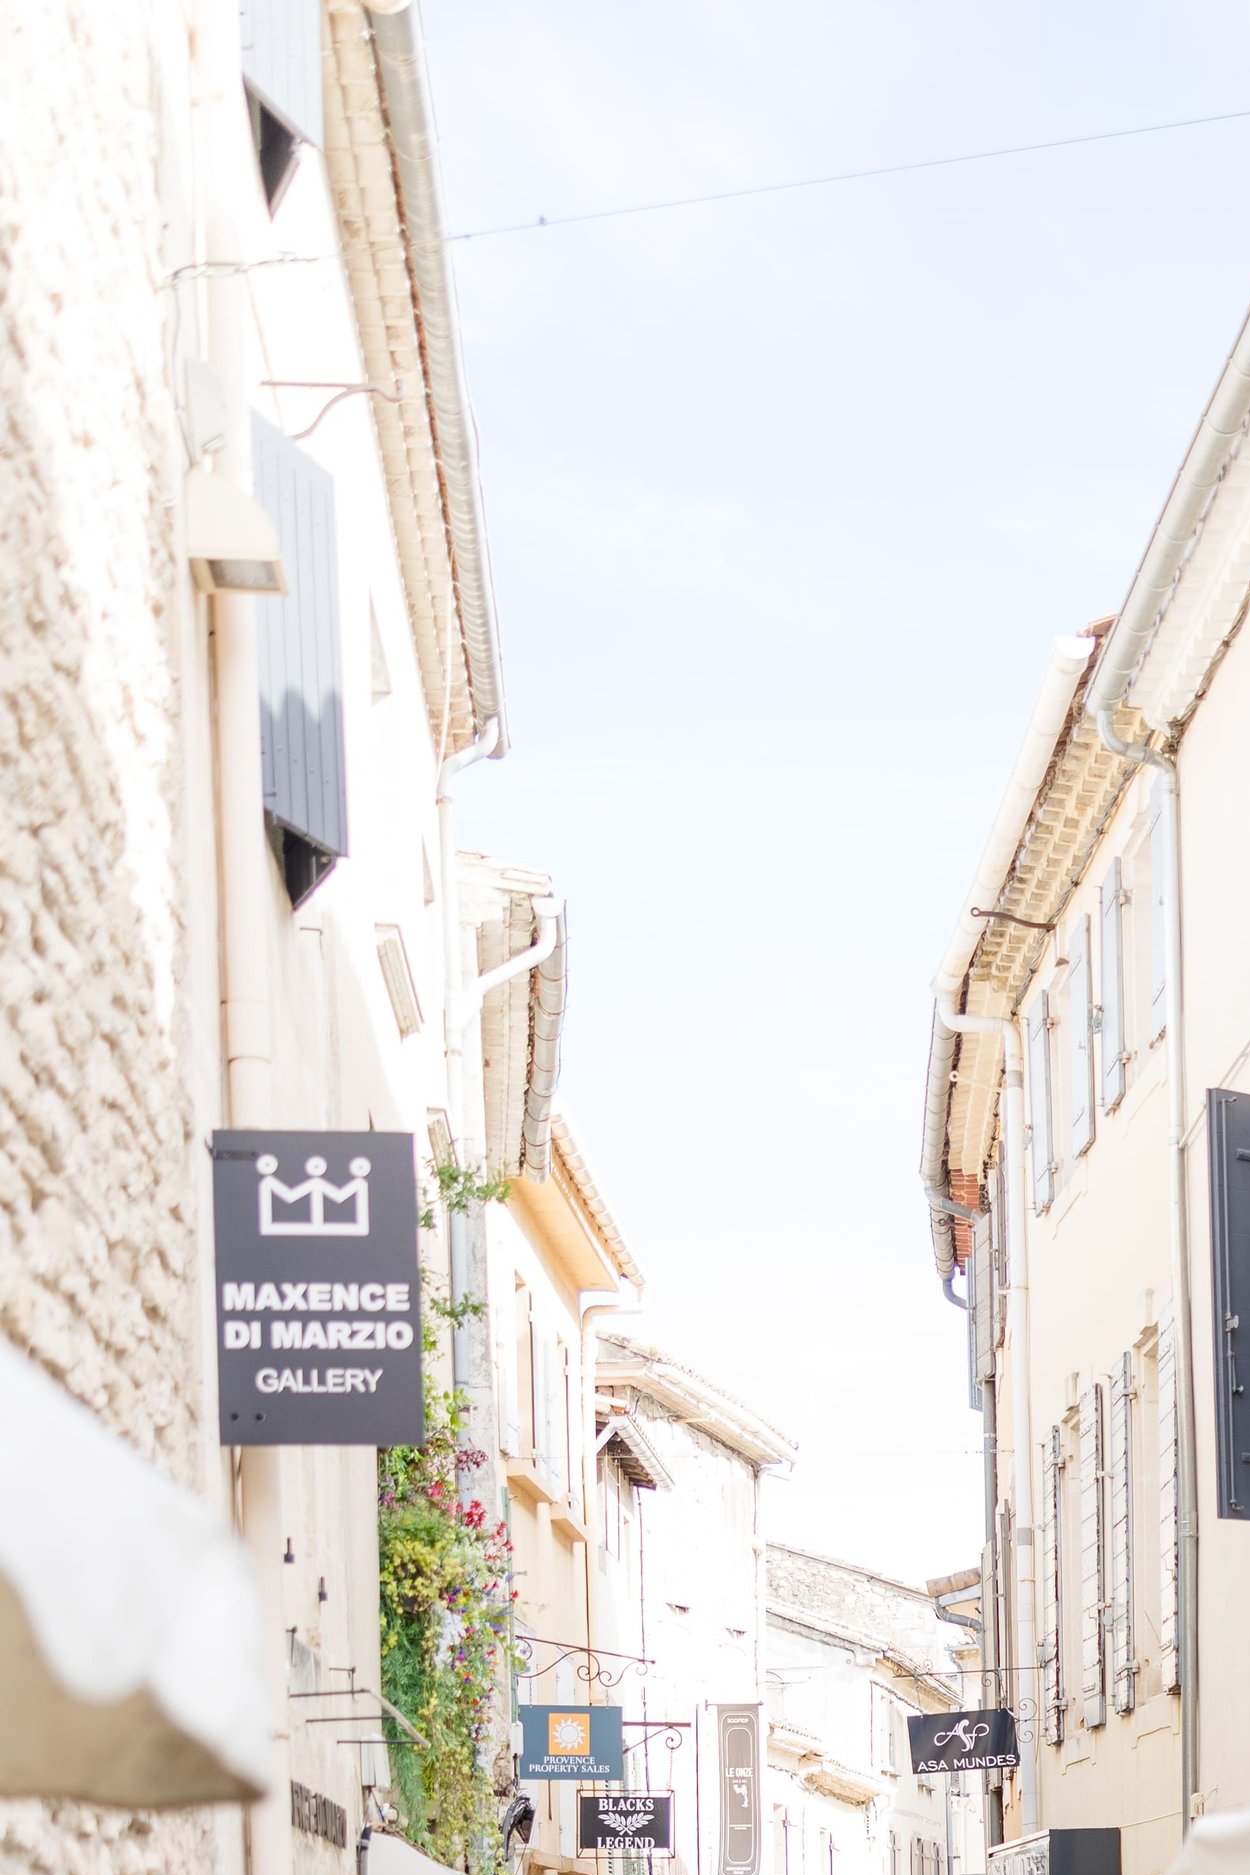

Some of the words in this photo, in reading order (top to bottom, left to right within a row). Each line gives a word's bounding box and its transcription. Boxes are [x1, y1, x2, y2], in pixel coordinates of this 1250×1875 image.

[222, 1281, 411, 1312] MAXENCE
[223, 1320, 262, 1350] DI
[270, 1320, 414, 1351] MARZIO
[254, 1366, 384, 1394] GALLERY
[543, 1756, 596, 1765] PROVENCE
[917, 1759, 949, 1773] ASA
[953, 1754, 1017, 1770] MUNDES
[529, 1764, 579, 1773] PROPERTY
[581, 1765, 610, 1774] SALES
[725, 1767, 735, 1778] LE
[735, 1767, 754, 1778] ONZE
[598, 1798, 655, 1811] BLACKS
[597, 1836, 656, 1849] LEGEND
